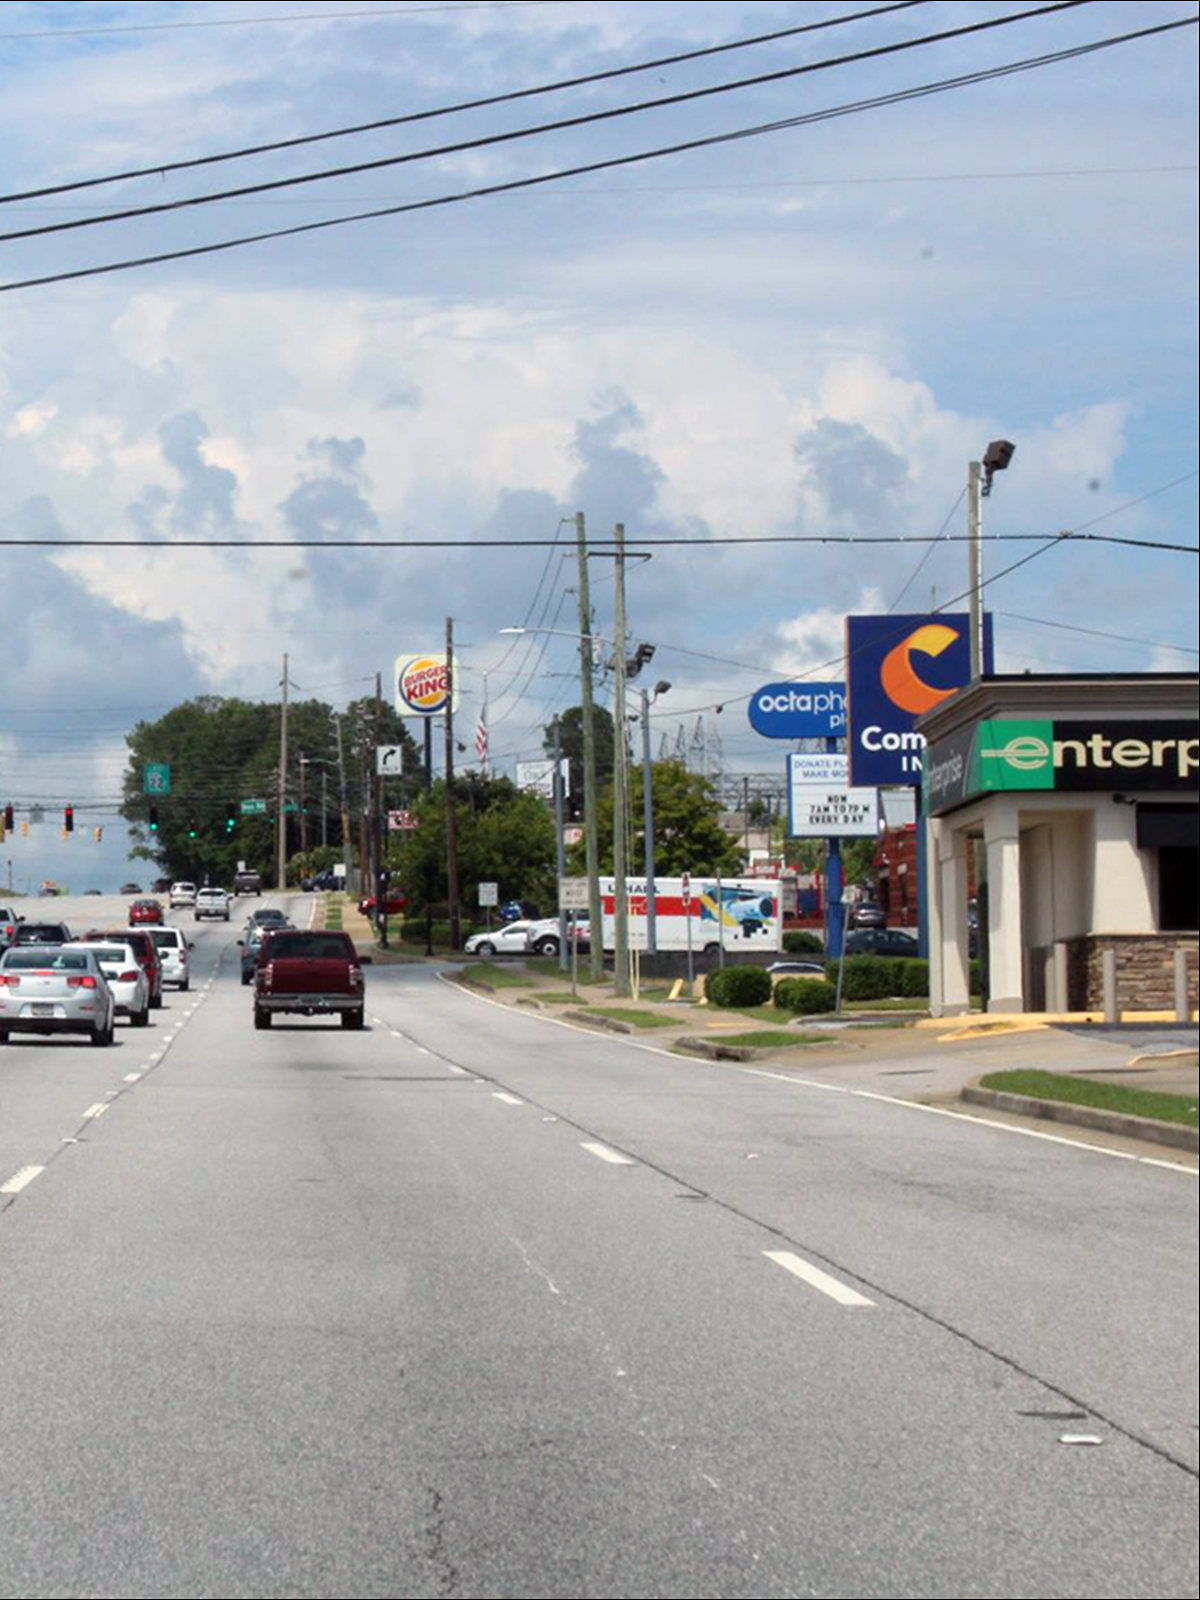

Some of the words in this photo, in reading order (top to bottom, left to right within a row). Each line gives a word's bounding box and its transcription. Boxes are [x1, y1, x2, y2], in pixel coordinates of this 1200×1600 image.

[404, 664, 447, 687] BURGER
[406, 676, 448, 701] KING
[829, 713, 846, 729] pl
[861, 725, 927, 751] Com
[793, 761, 831, 769] DONATE
[802, 769, 829, 778] MAKE
[831, 769, 848, 778] MO
[827, 795, 847, 804] NOW
[809, 815, 838, 824] EVERY
[843, 815, 864, 823] DAY
[608, 885, 661, 894] UHAL
